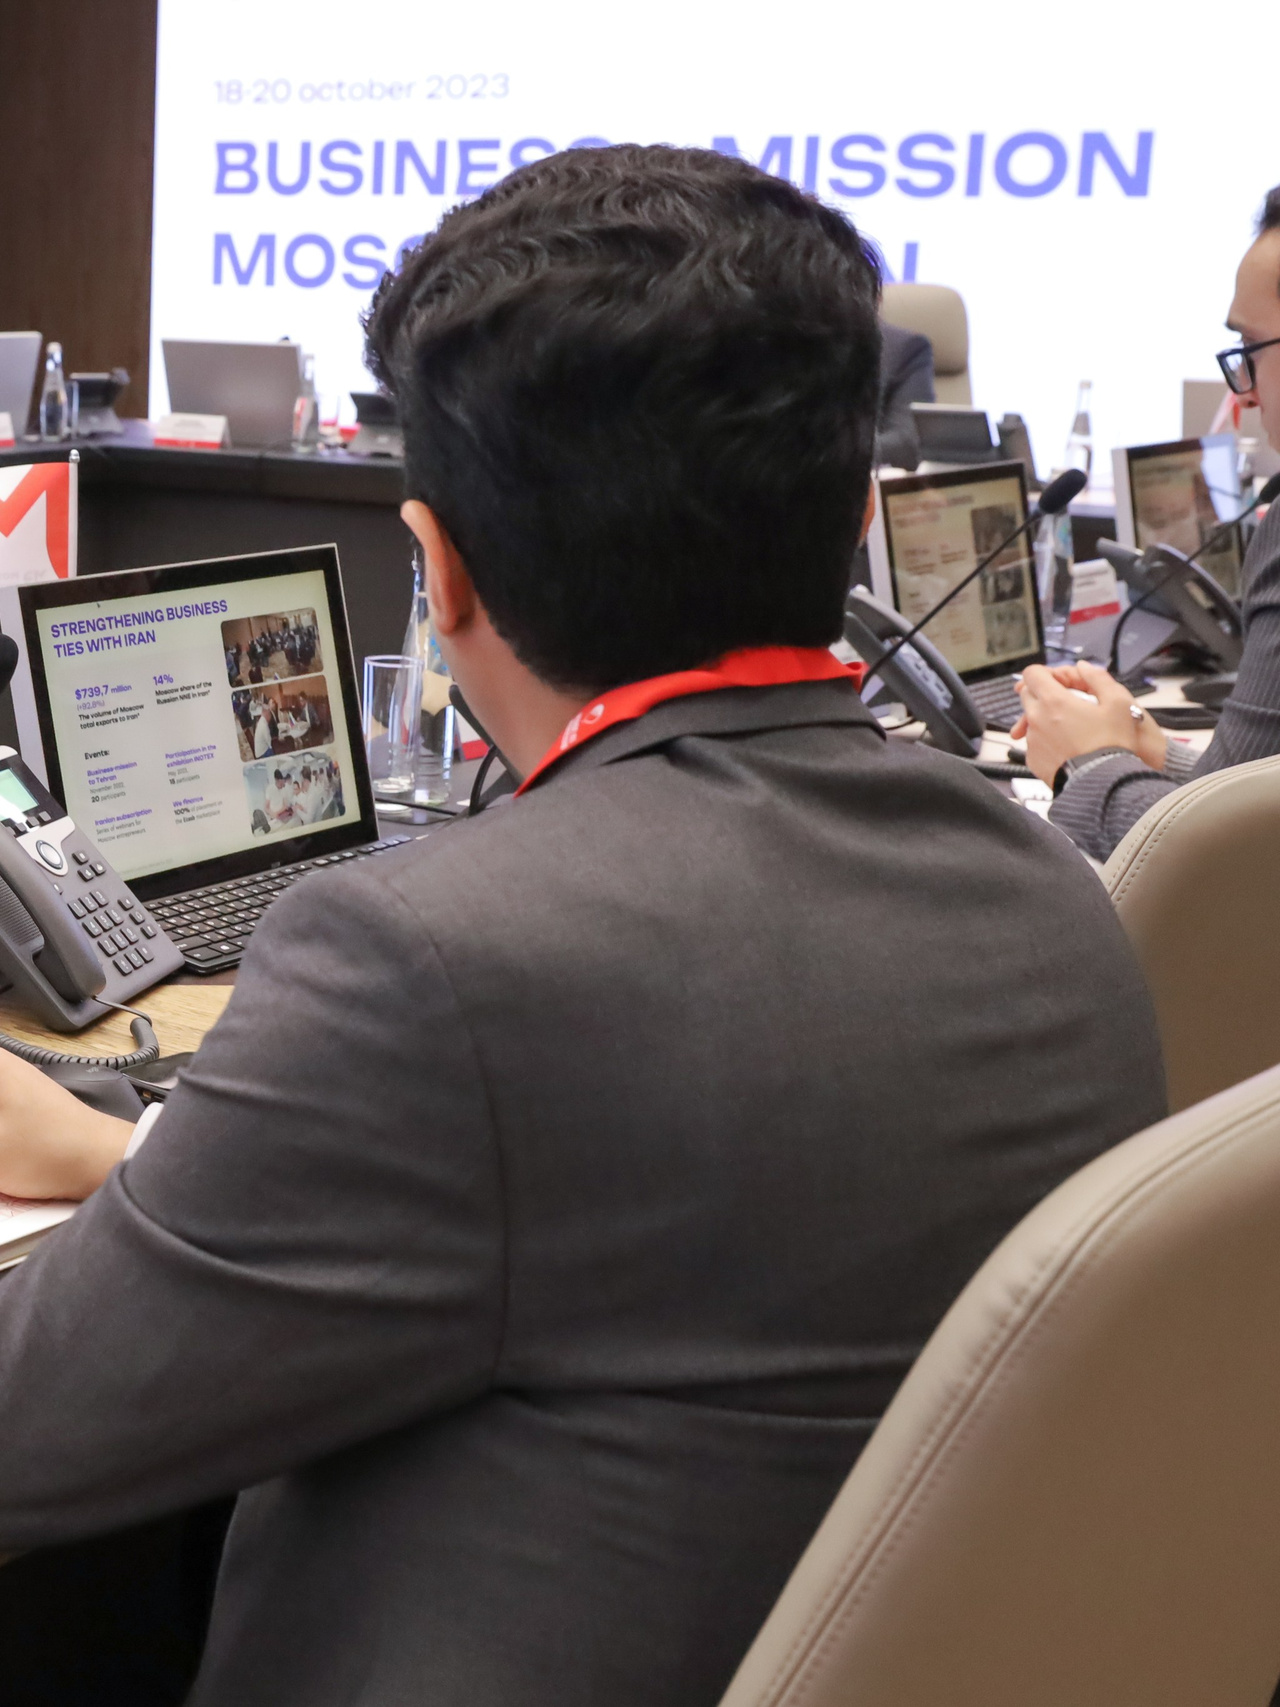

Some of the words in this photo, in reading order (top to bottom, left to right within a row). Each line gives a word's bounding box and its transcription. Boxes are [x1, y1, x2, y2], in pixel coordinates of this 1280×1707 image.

[297, 78, 417, 104] october
[425, 71, 511, 101] 2023
[214, 136, 613, 196] BUSINE
[51, 609, 164, 638] STRENGTHENING
[166, 599, 228, 621] BUSINESS
[53, 641, 84, 658] TIES
[85, 635, 122, 653] WITH
[124, 629, 156, 647] IRAN
[75, 684, 109, 700] $739,7
[153, 674, 174, 686] 14%
